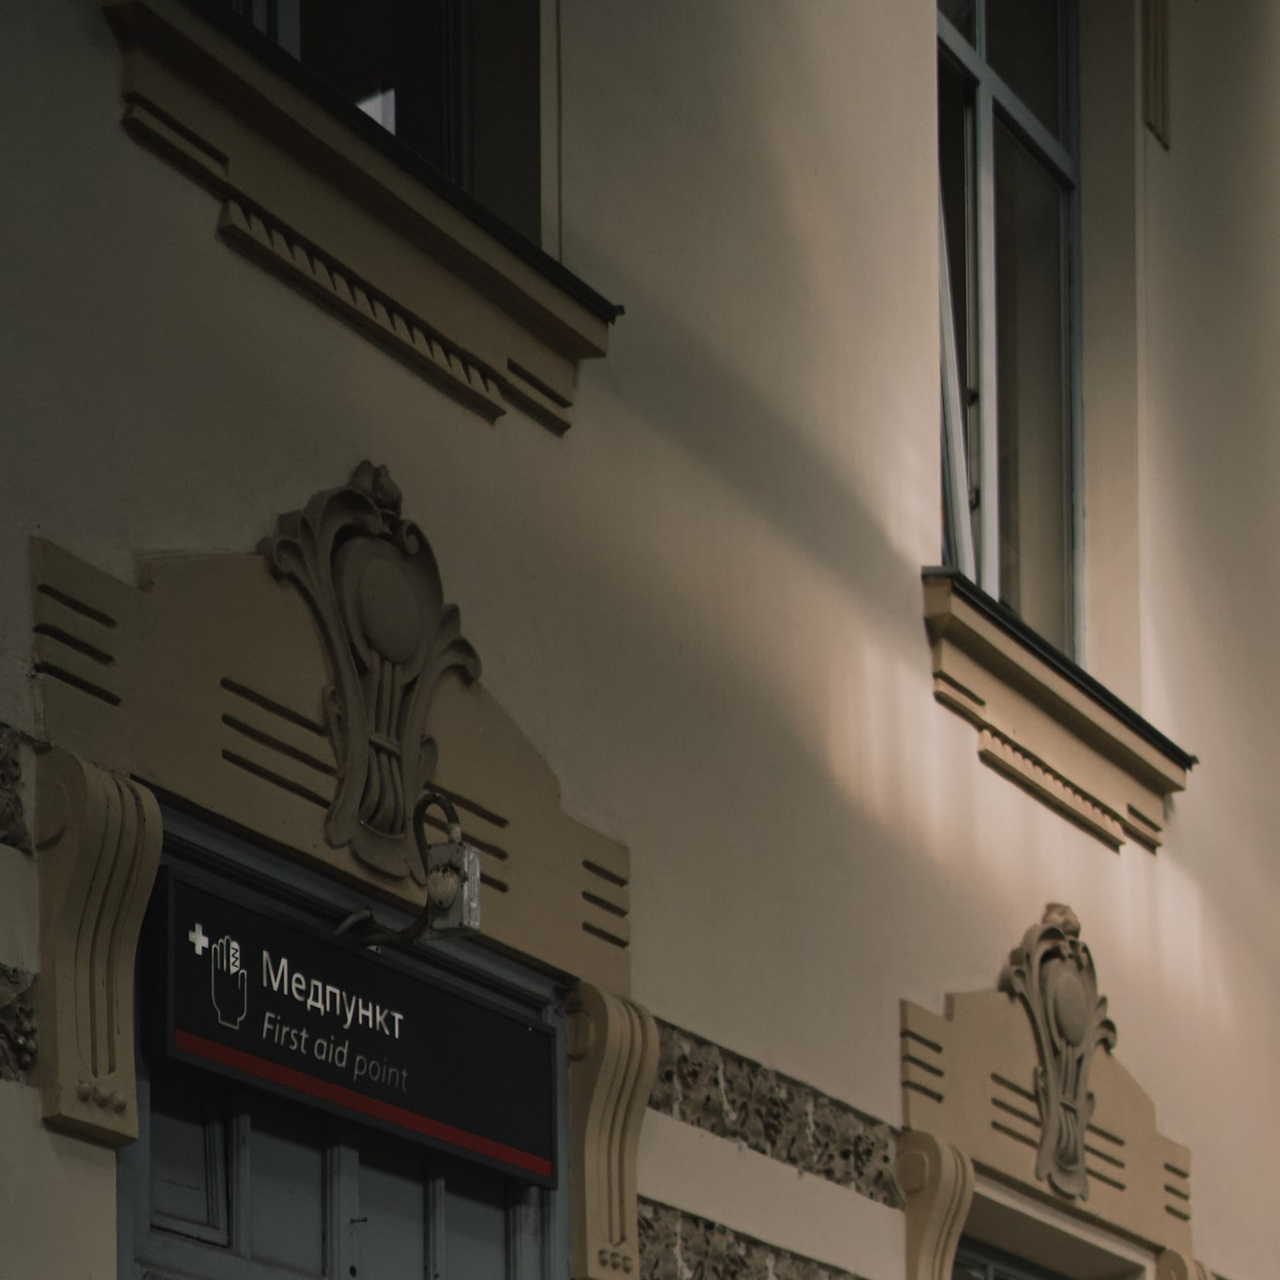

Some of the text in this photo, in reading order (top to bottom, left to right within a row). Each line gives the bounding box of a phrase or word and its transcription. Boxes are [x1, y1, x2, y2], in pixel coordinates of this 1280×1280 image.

[262, 950, 404, 1039] Медпункт
[263, 1011, 408, 1093] First aid point
